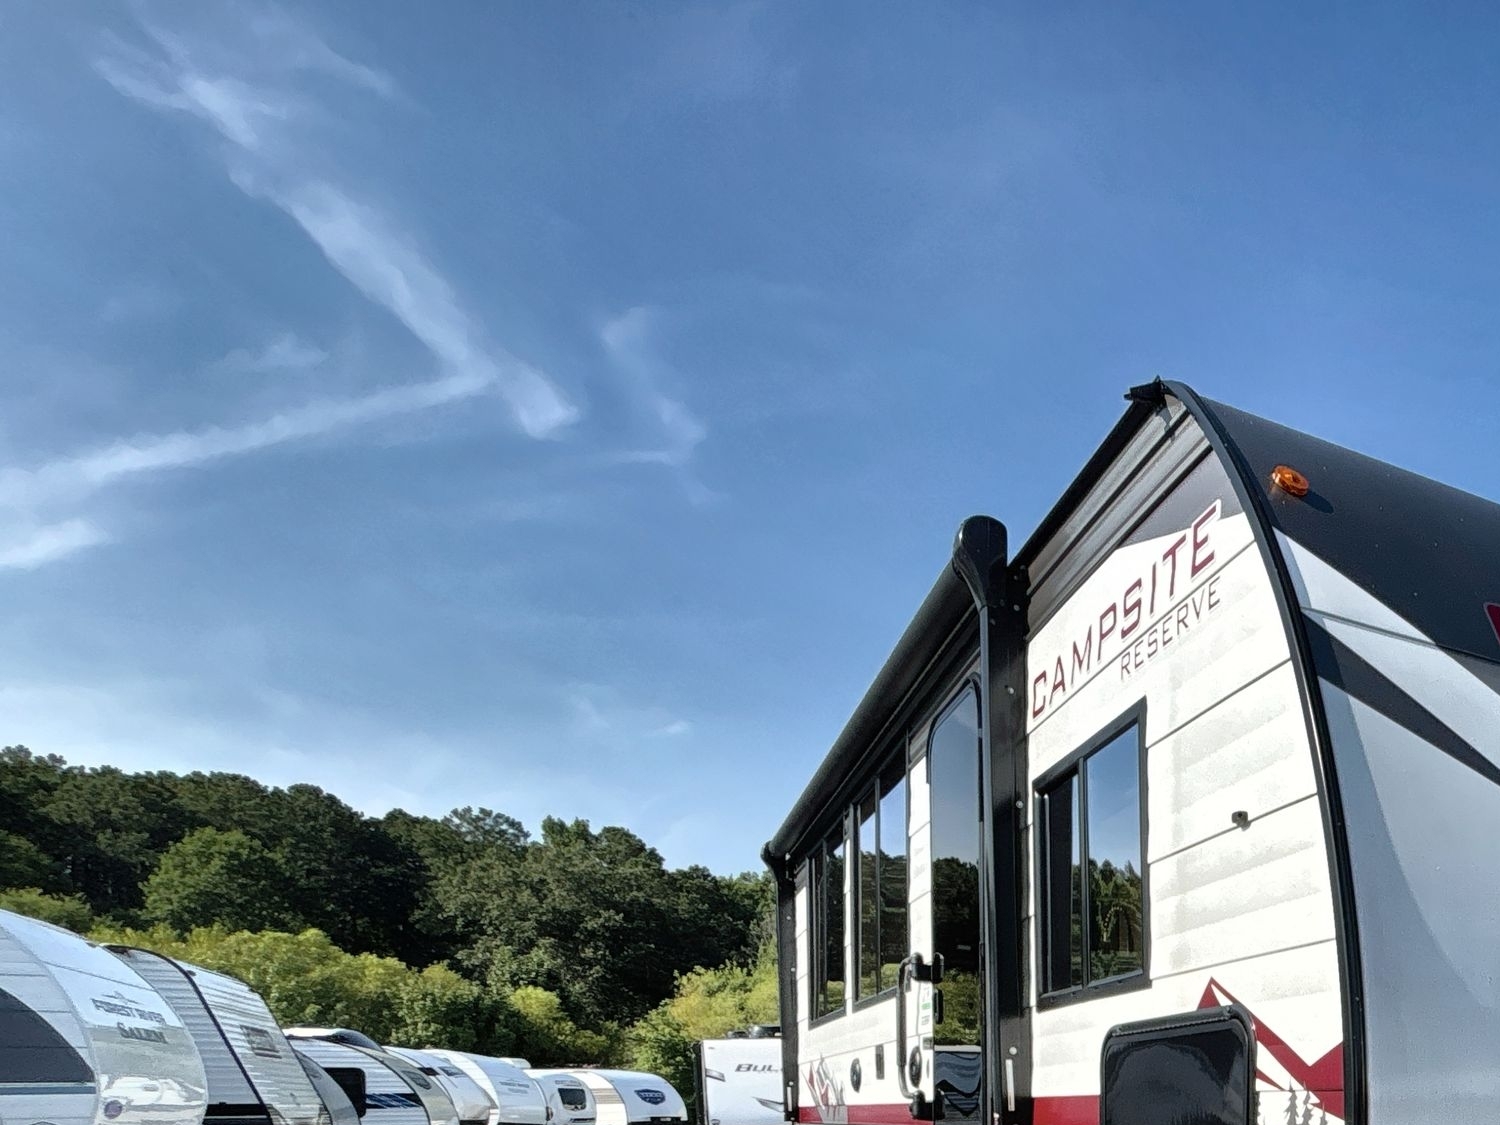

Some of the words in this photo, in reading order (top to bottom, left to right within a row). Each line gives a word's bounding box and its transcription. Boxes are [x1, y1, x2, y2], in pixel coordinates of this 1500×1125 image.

[1032, 504, 1228, 720] CAMPSITE
[1120, 576, 1221, 683] RESERVE
[735, 1063, 783, 1073] BUL
